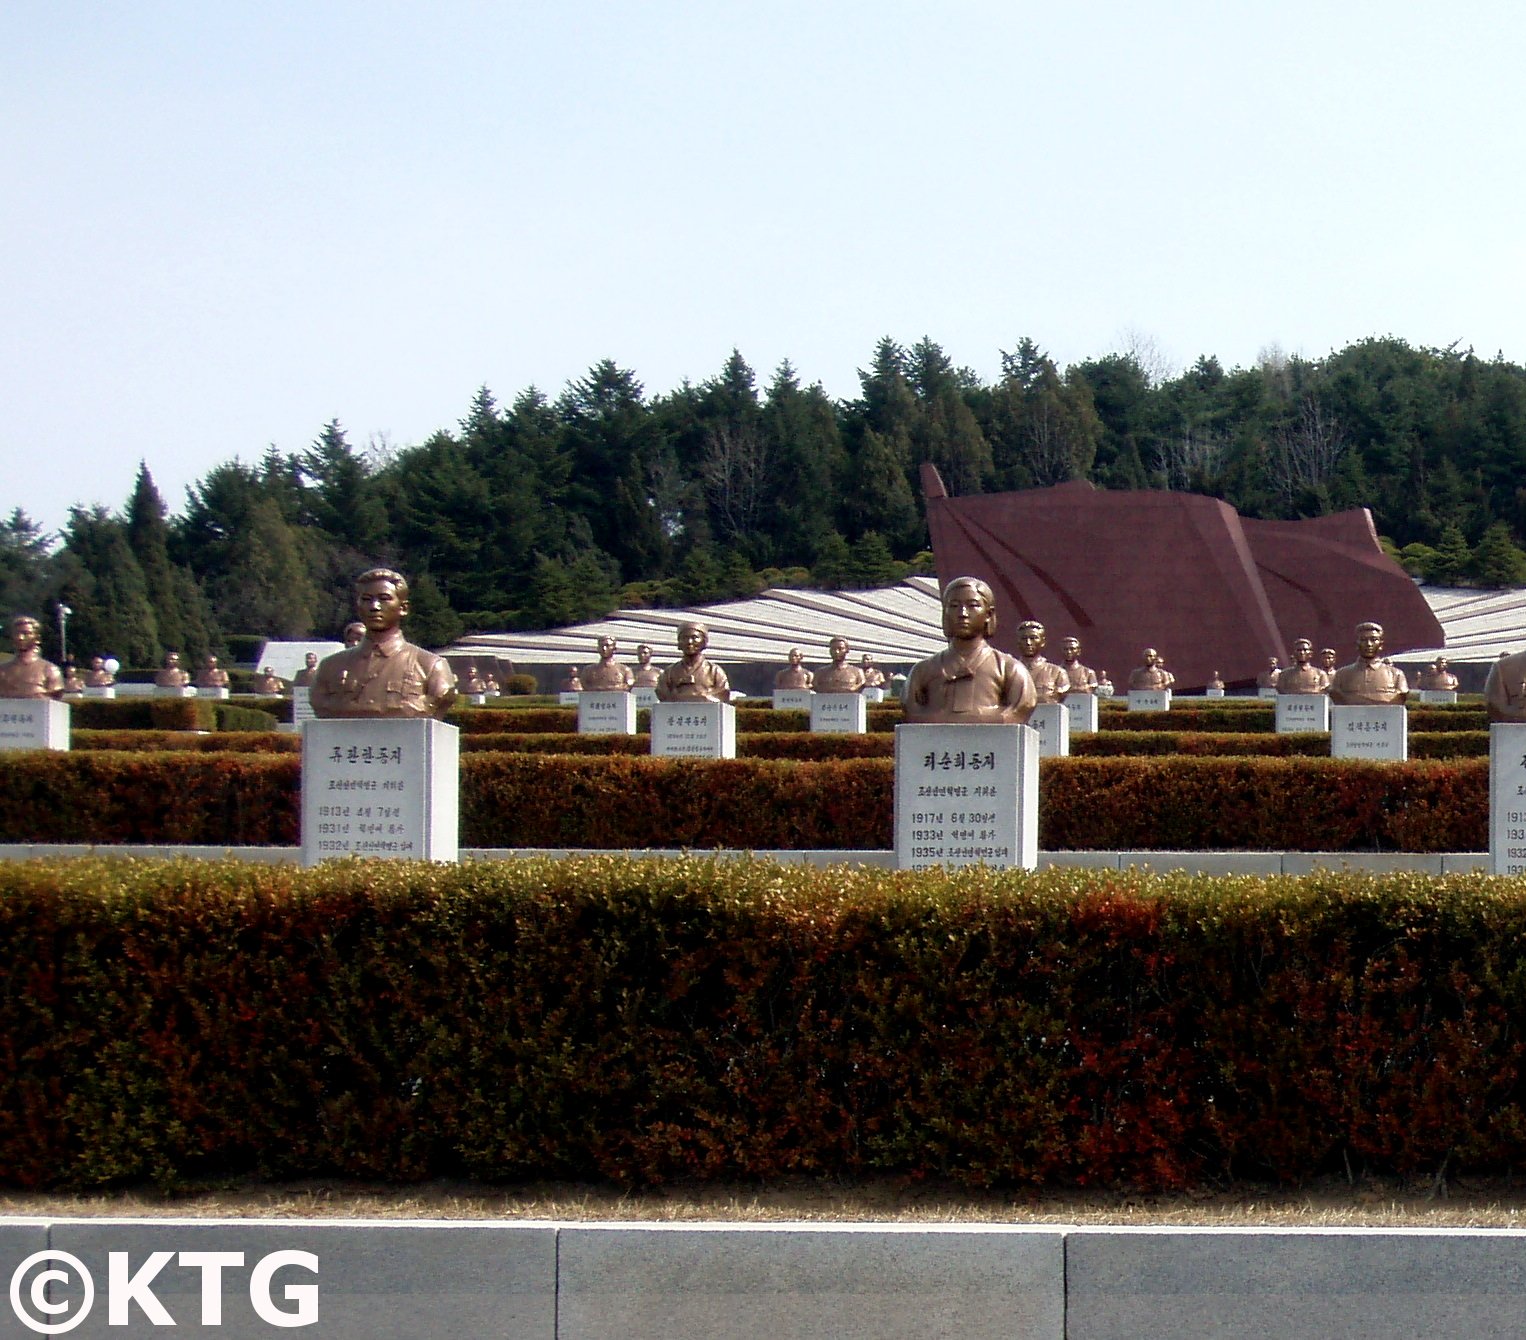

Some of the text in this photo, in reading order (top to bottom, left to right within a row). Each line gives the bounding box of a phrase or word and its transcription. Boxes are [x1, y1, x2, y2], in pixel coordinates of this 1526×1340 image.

[911, 812, 944, 824] 1917년
[911, 829, 944, 841] 1933년
[911, 847, 944, 858] 1935년
